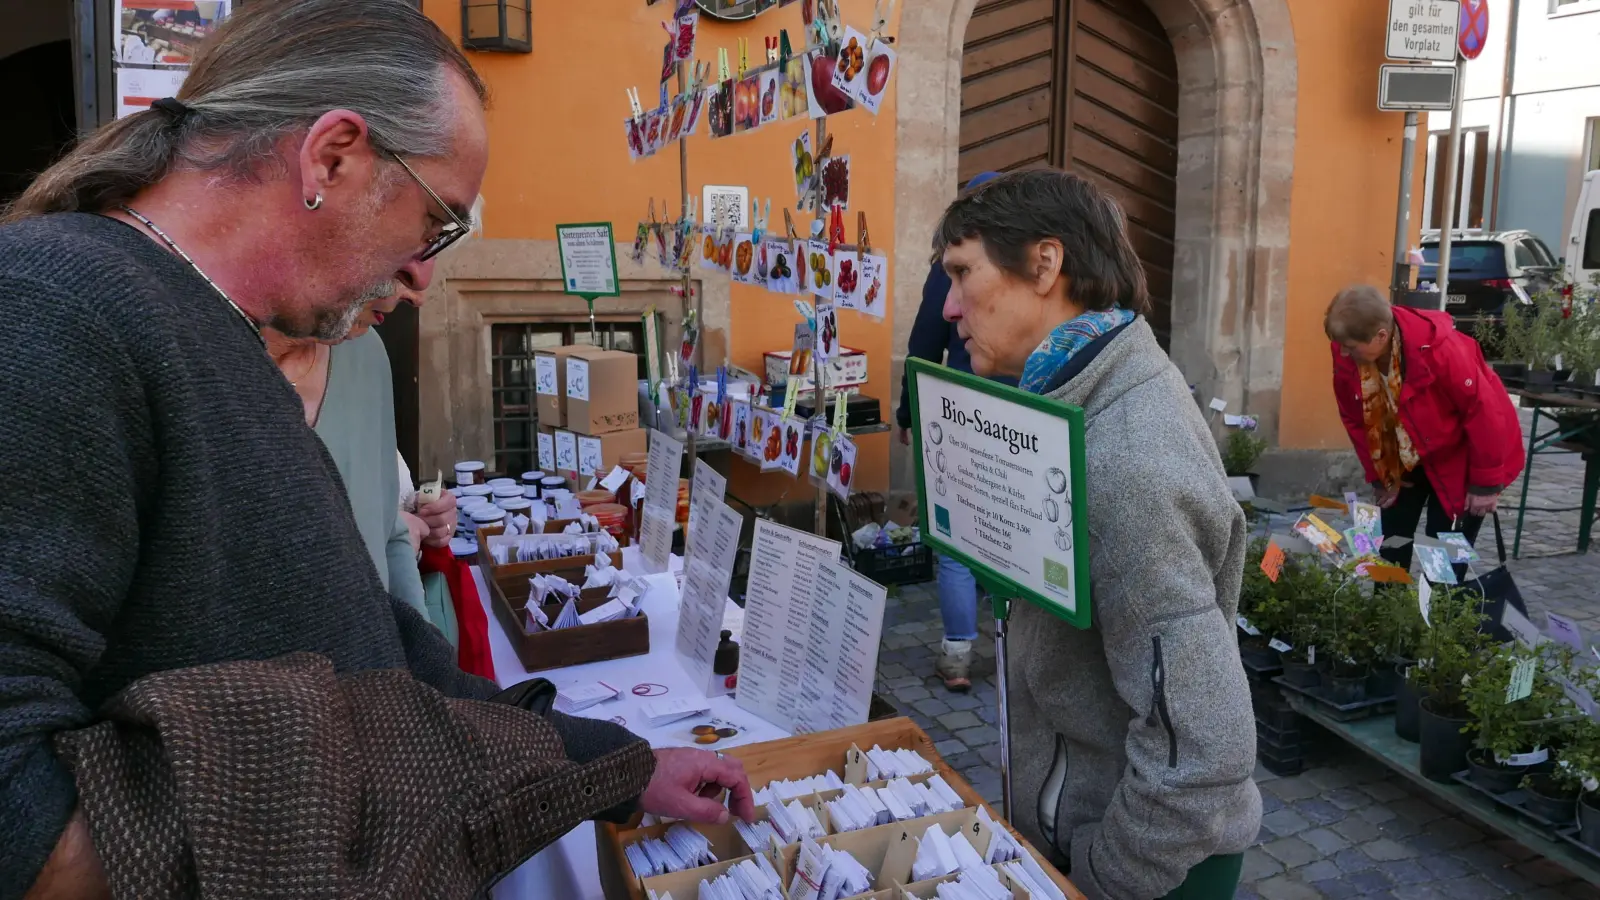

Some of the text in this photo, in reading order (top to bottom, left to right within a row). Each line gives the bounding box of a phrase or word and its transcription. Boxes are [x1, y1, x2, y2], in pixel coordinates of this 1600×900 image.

[1409, 4, 1442, 18] gilt für
[1392, 19, 1454, 35] den gesamten
[1404, 37, 1441, 53] Vorplatz
[941, 396, 1039, 455] Bio-Saatgut
[949, 434, 959, 447] Über
[995, 454, 1033, 477] Tomatensorten
[971, 458, 988, 471] Paprika
[995, 468, 1007, 480] Chili
[946, 471, 957, 483] Viele
[992, 494, 1009, 507] speziell
[1010, 499, 1020, 511] fürs
[1020, 504, 1043, 521] Freiland
[976, 474, 1001, 490] Aubergine
[1008, 486, 1025, 501] Kürbis
[956, 493, 976, 510] Tütchen
[977, 506, 986, 514] mit
[992, 511, 999, 521] 10
[1016, 522, 1032, 536] 3,50€
[973, 515, 1012, 540] 5 Tütchen: 16€
[979, 529, 1002, 547] Tütchen:
